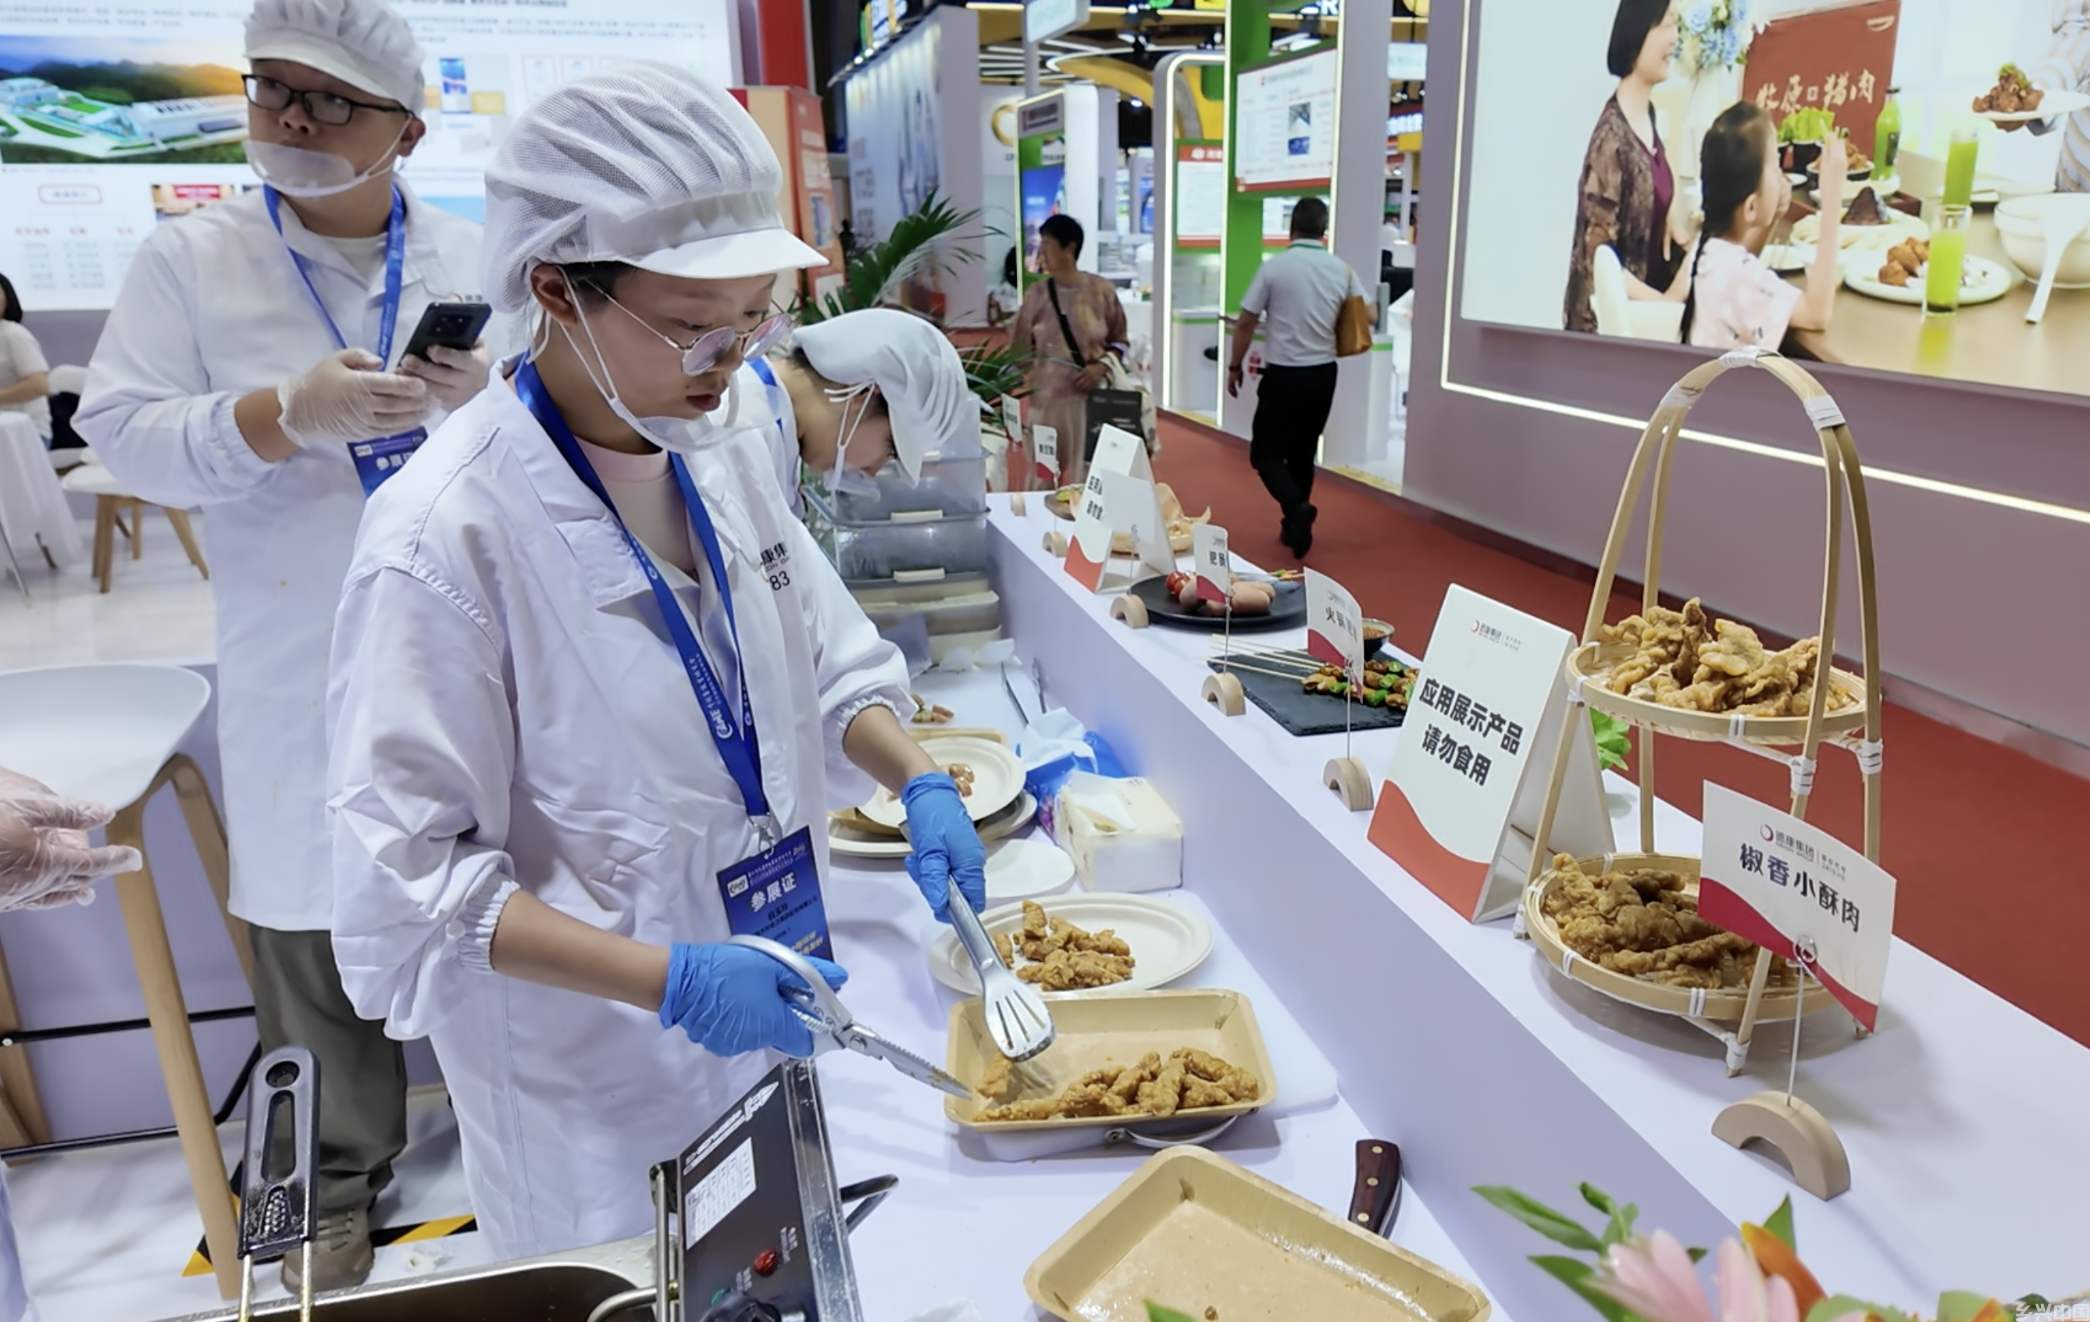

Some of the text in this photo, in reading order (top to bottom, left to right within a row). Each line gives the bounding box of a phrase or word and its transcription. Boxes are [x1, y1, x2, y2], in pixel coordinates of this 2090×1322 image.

[769, 570, 791, 591] 83
[1418, 677, 1524, 756] 应用展示产品
[1421, 723, 1492, 787] 请勿食用
[751, 871, 796, 913] 参展证
[1739, 842, 1860, 933] 椒香小酥肉
